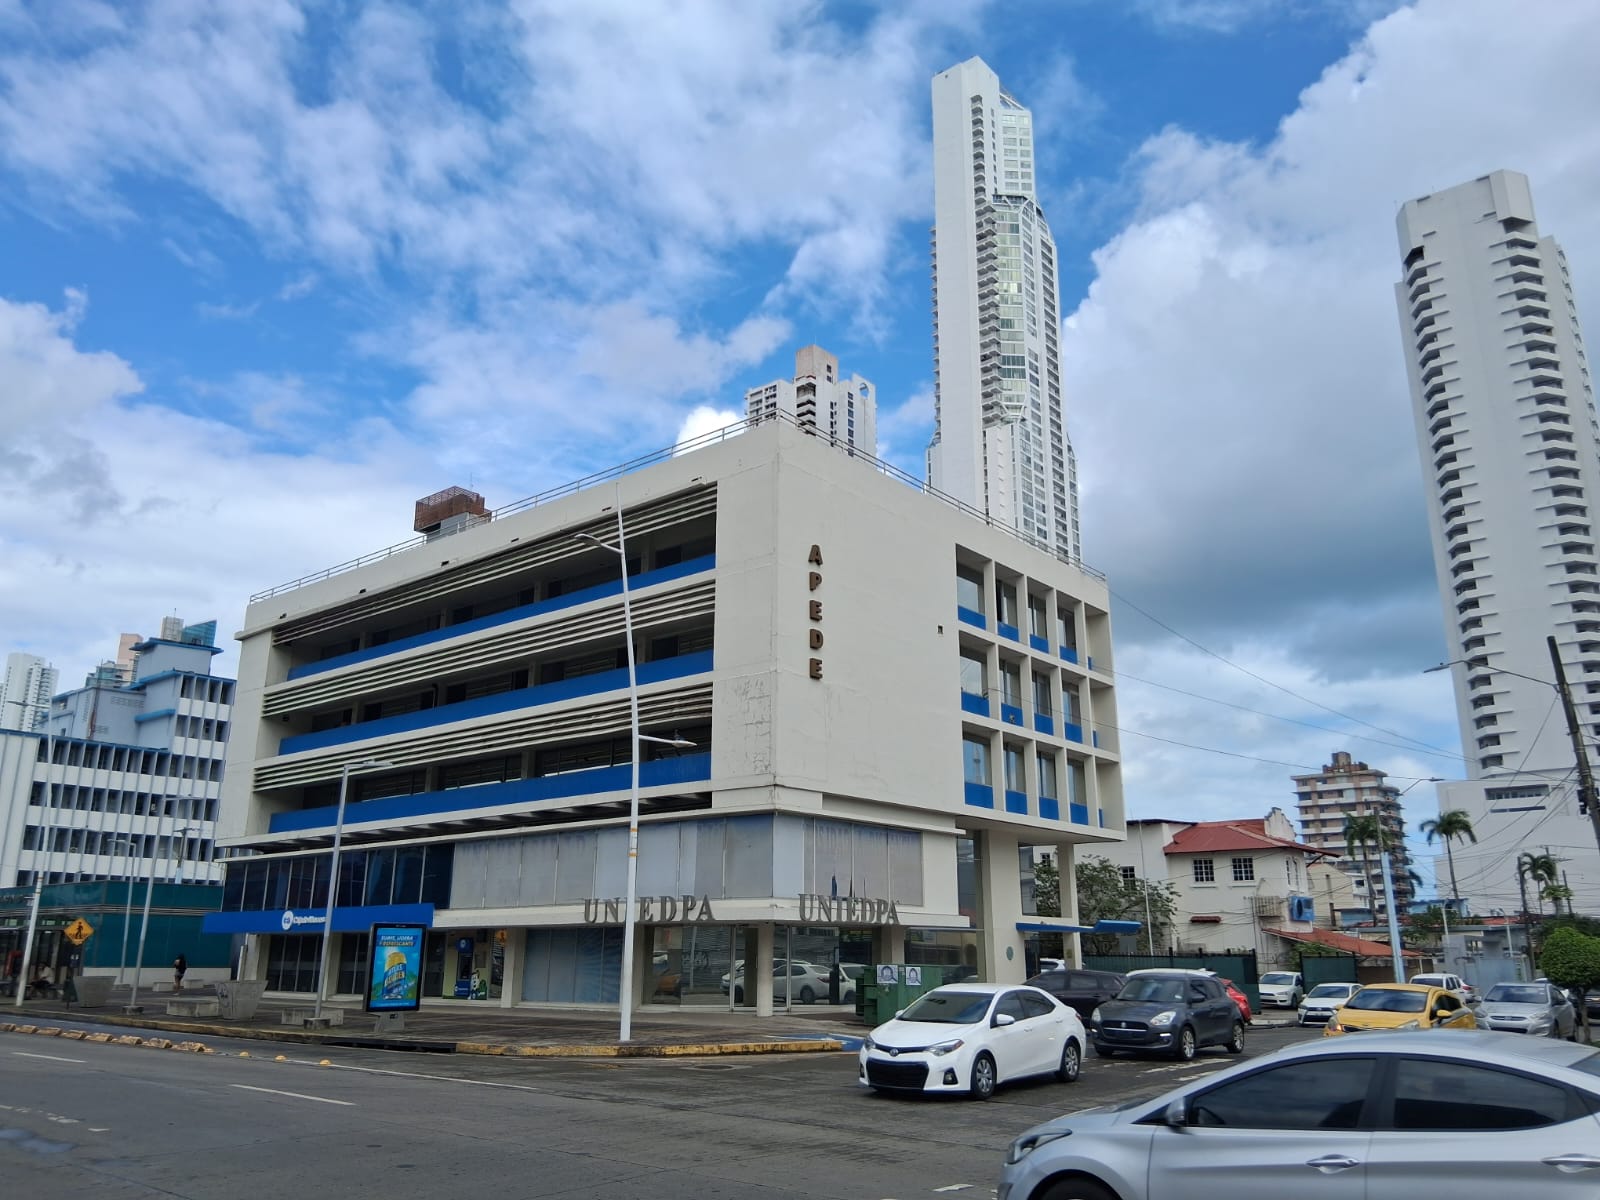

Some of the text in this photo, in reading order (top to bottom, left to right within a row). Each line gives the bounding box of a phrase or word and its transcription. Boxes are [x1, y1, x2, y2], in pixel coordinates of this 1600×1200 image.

[808, 544, 823, 681] APEDE
[584, 894, 716, 923] UNEDPA
[798, 893, 900, 924] UNIEDPA
